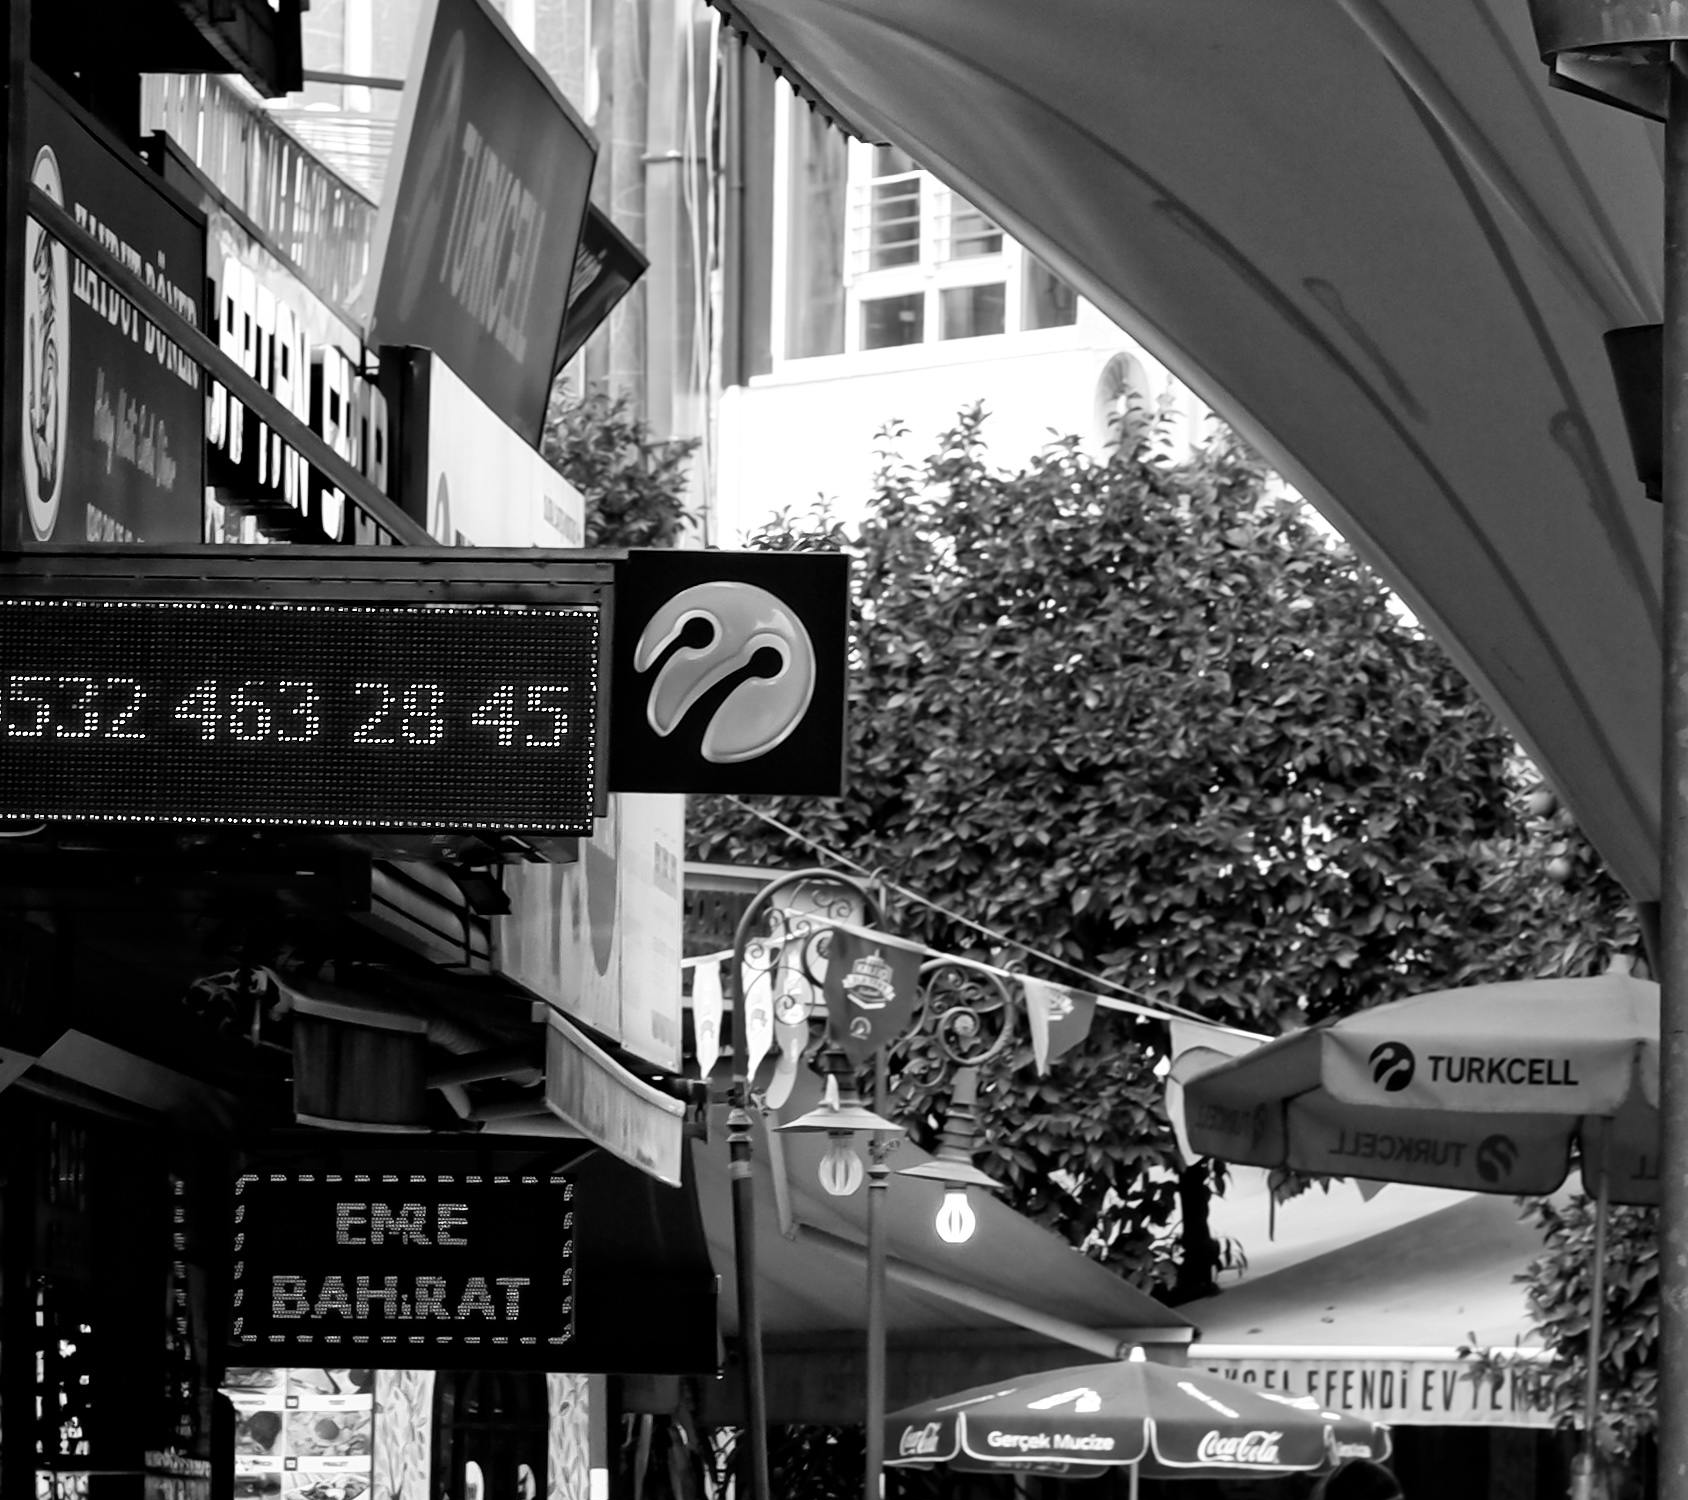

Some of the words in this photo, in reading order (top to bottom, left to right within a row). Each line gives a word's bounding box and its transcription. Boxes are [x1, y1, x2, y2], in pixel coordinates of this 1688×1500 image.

[0, 675, 147, 740] 532
[174, 679, 322, 743] 463
[353, 682, 445, 746] 28
[471, 684, 570, 748] 45
[1428, 1055, 1580, 1086] TURKCELL
[335, 1202, 469, 1246] EMRE
[986, 1430, 1051, 1452] Gerçek
[1052, 1432, 1116, 1452] Mucize
